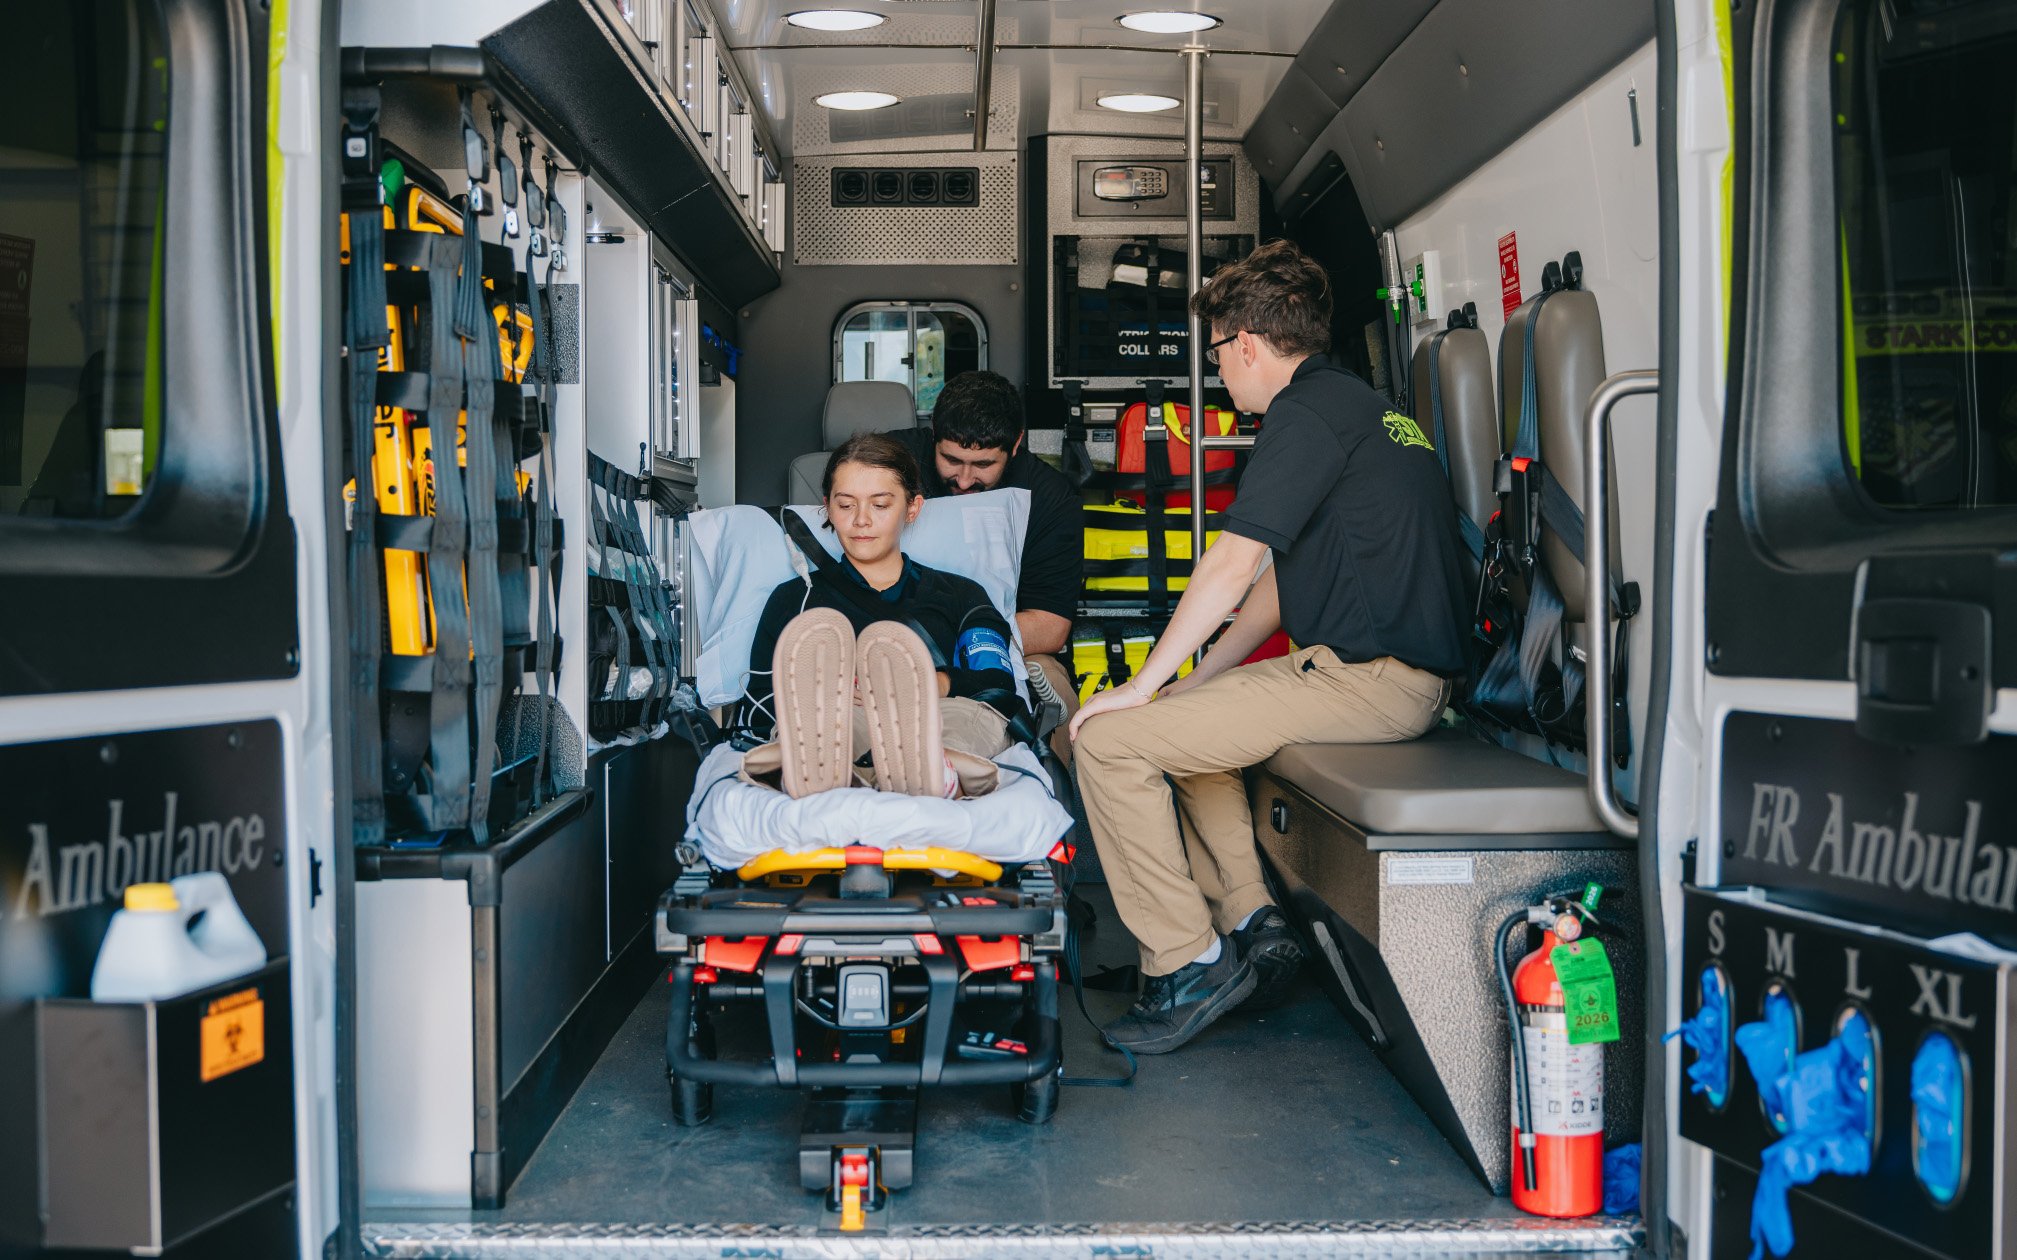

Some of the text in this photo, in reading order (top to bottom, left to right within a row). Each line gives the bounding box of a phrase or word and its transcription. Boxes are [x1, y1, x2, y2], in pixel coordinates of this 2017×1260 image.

[1118, 344, 1179, 356] COLLRS
[1743, 782, 1799, 867] FR
[13, 791, 266, 921] Ambulance
[1585, 886, 1598, 906] 2026
[1708, 909, 1726, 956] S
[1765, 926, 1796, 979] M
[1844, 948, 1872, 999] L
[1909, 962, 1977, 1029] XL
[1575, 1011, 1610, 1027] 2026
